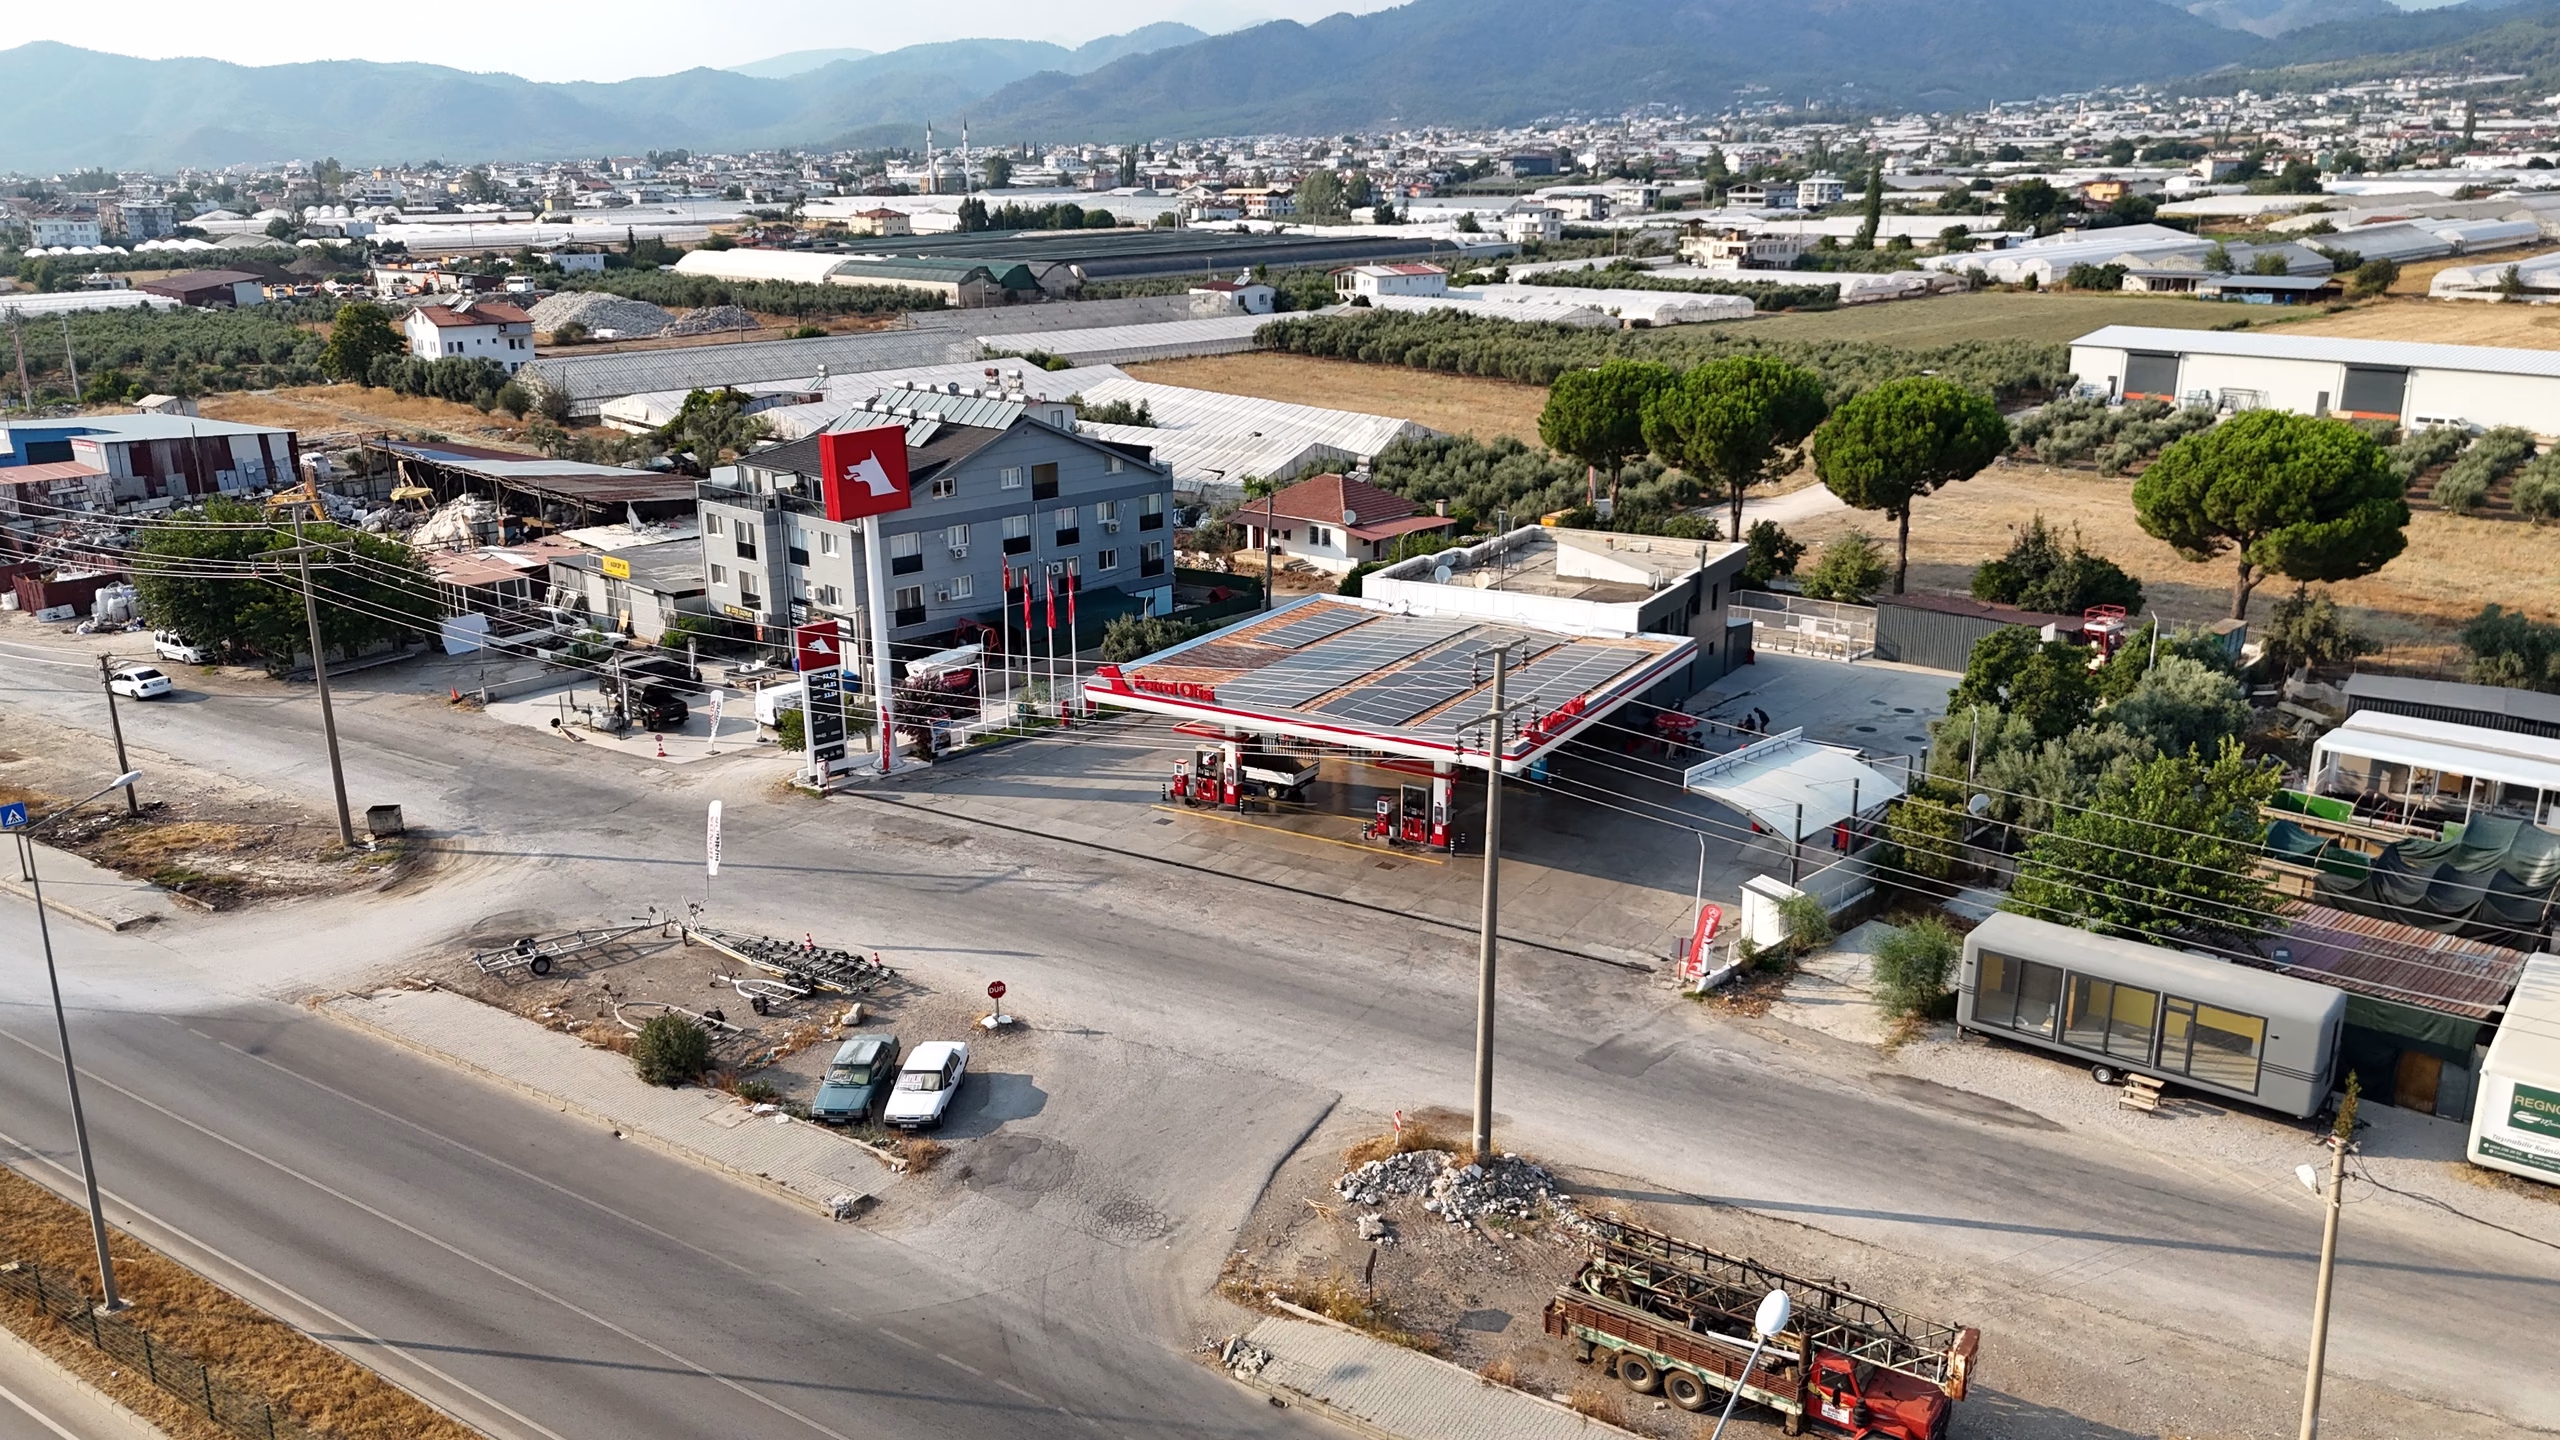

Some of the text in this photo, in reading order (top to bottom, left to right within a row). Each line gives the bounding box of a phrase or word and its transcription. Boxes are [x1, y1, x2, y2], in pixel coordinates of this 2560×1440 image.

[1134, 674, 1215, 701] Petrol Ofisi
[989, 985, 1004, 994] DUR
